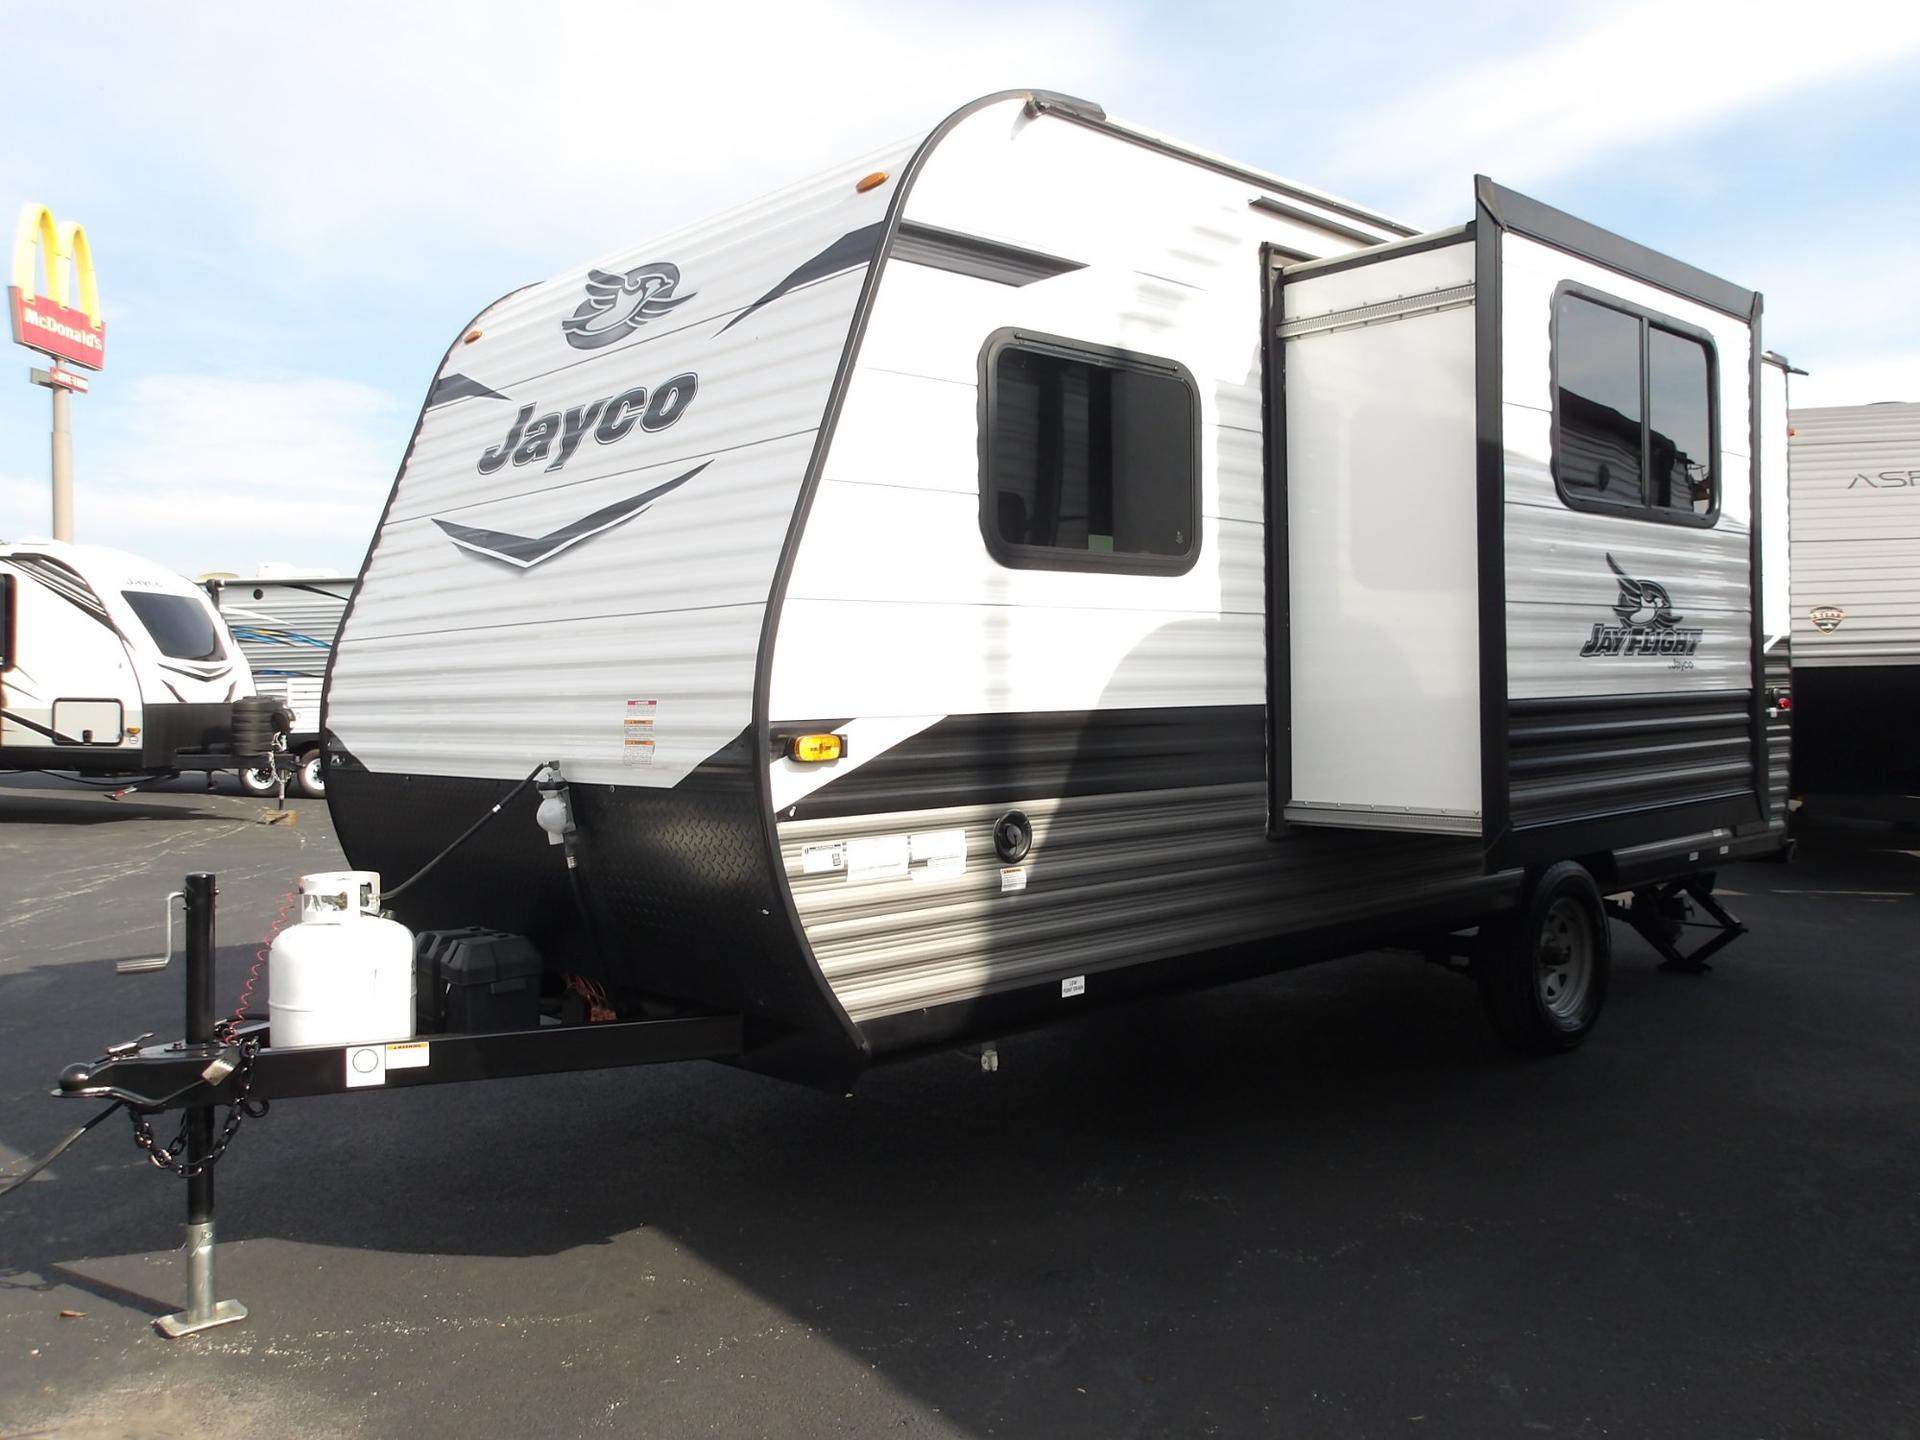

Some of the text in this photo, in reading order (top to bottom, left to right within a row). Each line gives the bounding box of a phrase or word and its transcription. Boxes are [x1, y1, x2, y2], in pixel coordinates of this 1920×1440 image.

[23, 307, 103, 351] McDonald's
[477, 371, 698, 476] Jayco
[1580, 623, 1703, 657] JAY FLIGHT
